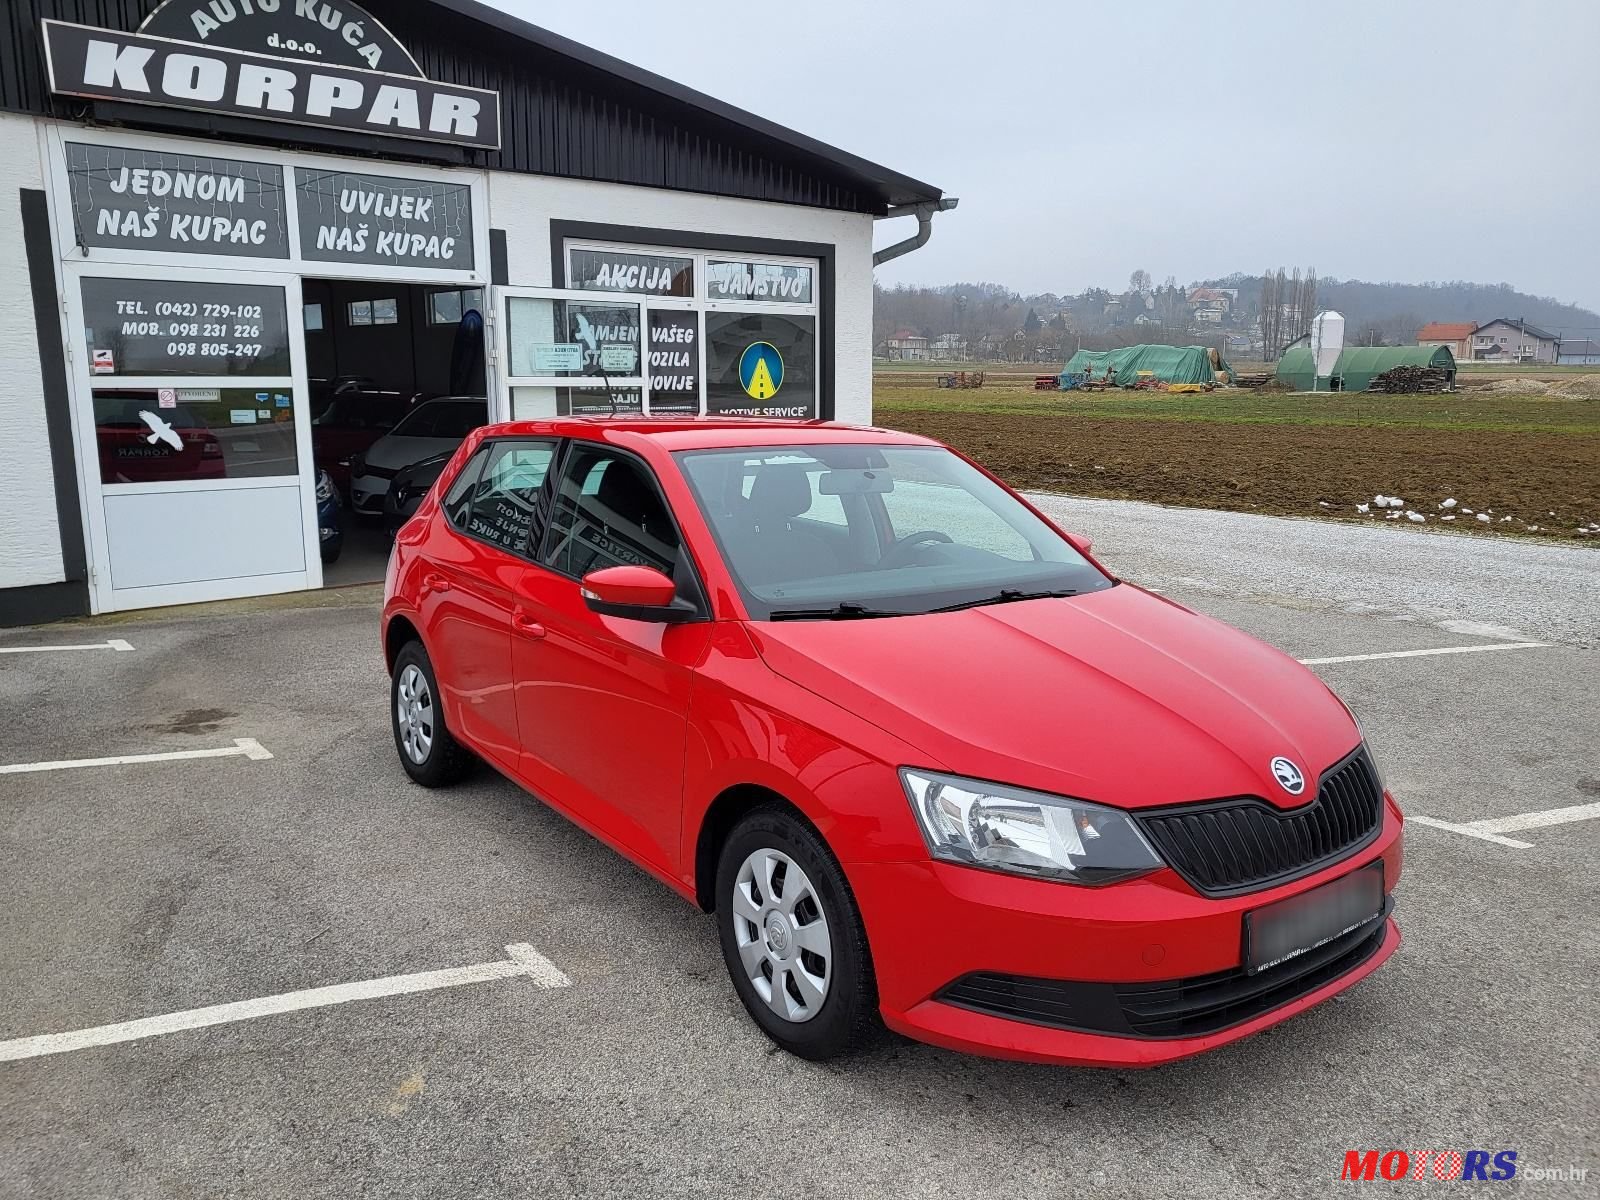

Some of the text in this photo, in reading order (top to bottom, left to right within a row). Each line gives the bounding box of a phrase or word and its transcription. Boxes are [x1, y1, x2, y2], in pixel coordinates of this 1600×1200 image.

[266, 33, 322, 54] d.o.o.
[295, 0, 383, 69] KUĆA
[83, 39, 481, 137] KORPAR
[110, 167, 246, 203] JEDNOM
[340, 189, 432, 222] UVIJEK
[97, 206, 267, 245] NAŠ KUPAC
[317, 224, 455, 259] NAŠ KUPAC
[597, 263, 672, 291] AKCIJA
[718, 271, 804, 297] JAMSTVO
[116, 301, 261, 319] TEL. (042) 729-102
[122, 322, 260, 338] MOB. 098 231 226
[652, 324, 694, 344] VAŠEG
[167, 342, 262, 357] 098 805-247
